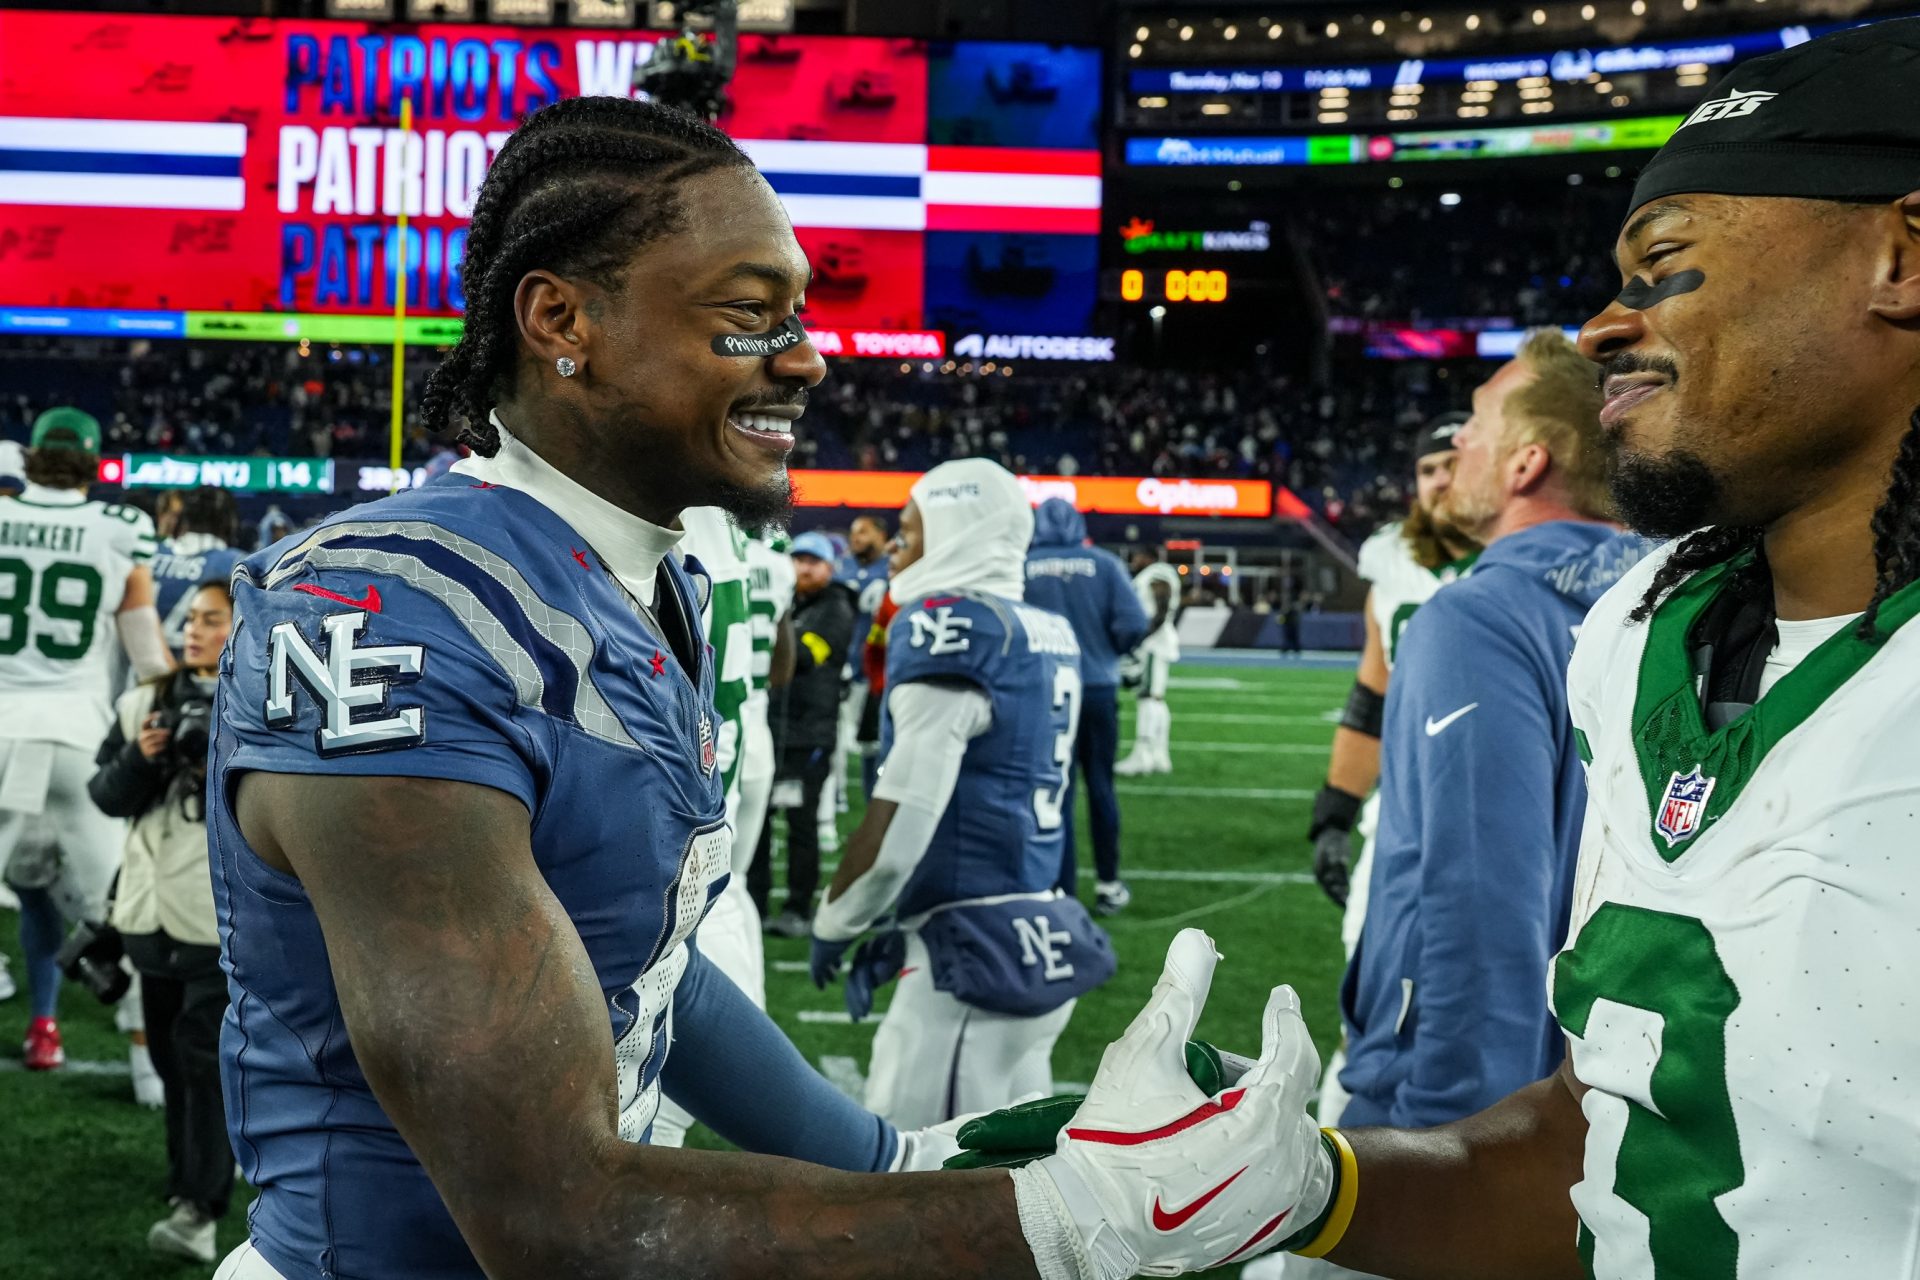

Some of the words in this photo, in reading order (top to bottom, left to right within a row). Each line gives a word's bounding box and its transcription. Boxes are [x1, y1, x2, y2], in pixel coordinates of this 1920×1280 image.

[285, 34, 562, 121] PATRIOTS
[576, 40, 654, 98] W
[1673, 88, 1779, 135] JETS
[277, 126, 508, 218] PATRIO
[1121, 269, 1143, 301] 0
[853, 330, 940, 356] TOYOTA
[985, 335, 1115, 361] AUTODESK
[1136, 477, 1238, 514] Optum
[909, 606, 973, 656] NE
[265, 611, 425, 757] NE
[1662, 799, 1692, 832] NFL
[1012, 916, 1074, 980] NE
